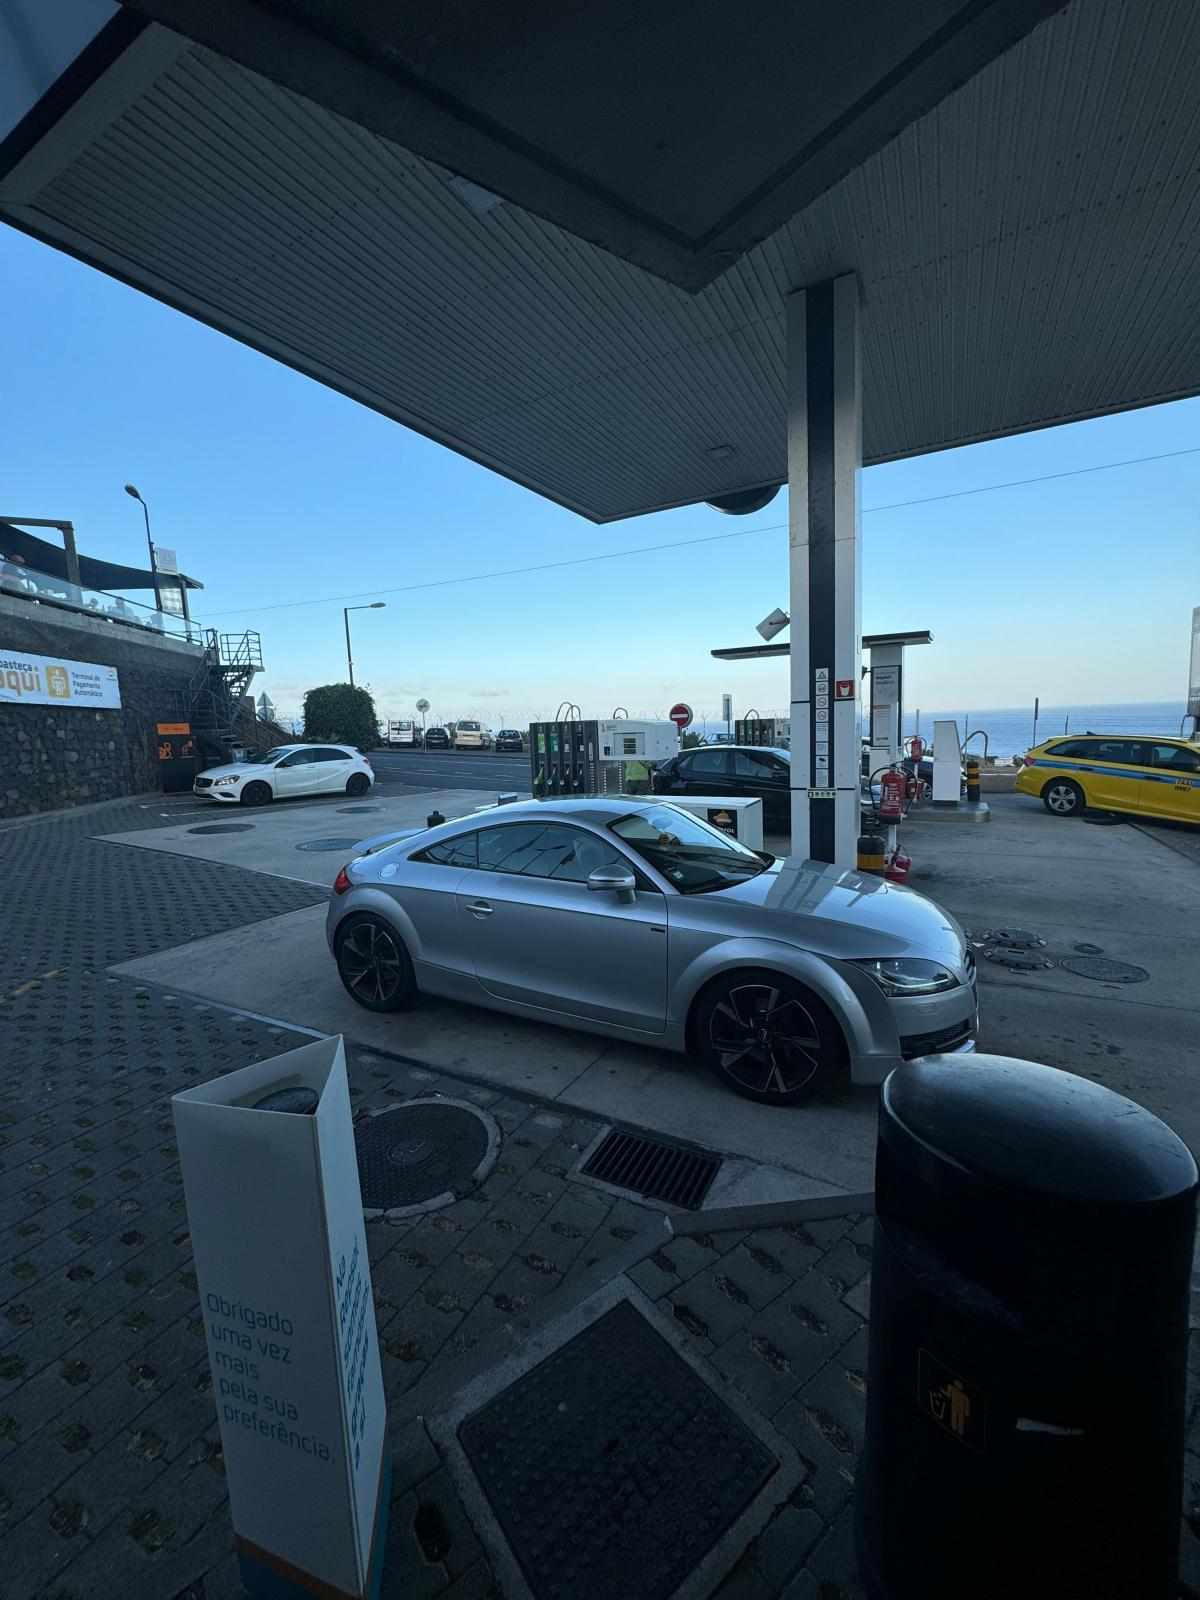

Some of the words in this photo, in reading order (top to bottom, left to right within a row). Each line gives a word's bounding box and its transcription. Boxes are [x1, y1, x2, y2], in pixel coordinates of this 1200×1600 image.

[207, 1293, 293, 1336] Obrigado
[211, 1323, 252, 1351] uma
[257, 1338, 291, 1364] vez
[215, 1352, 258, 1380] mais
[219, 1378, 257, 1405] pela
[263, 1395, 298, 1421] sua
